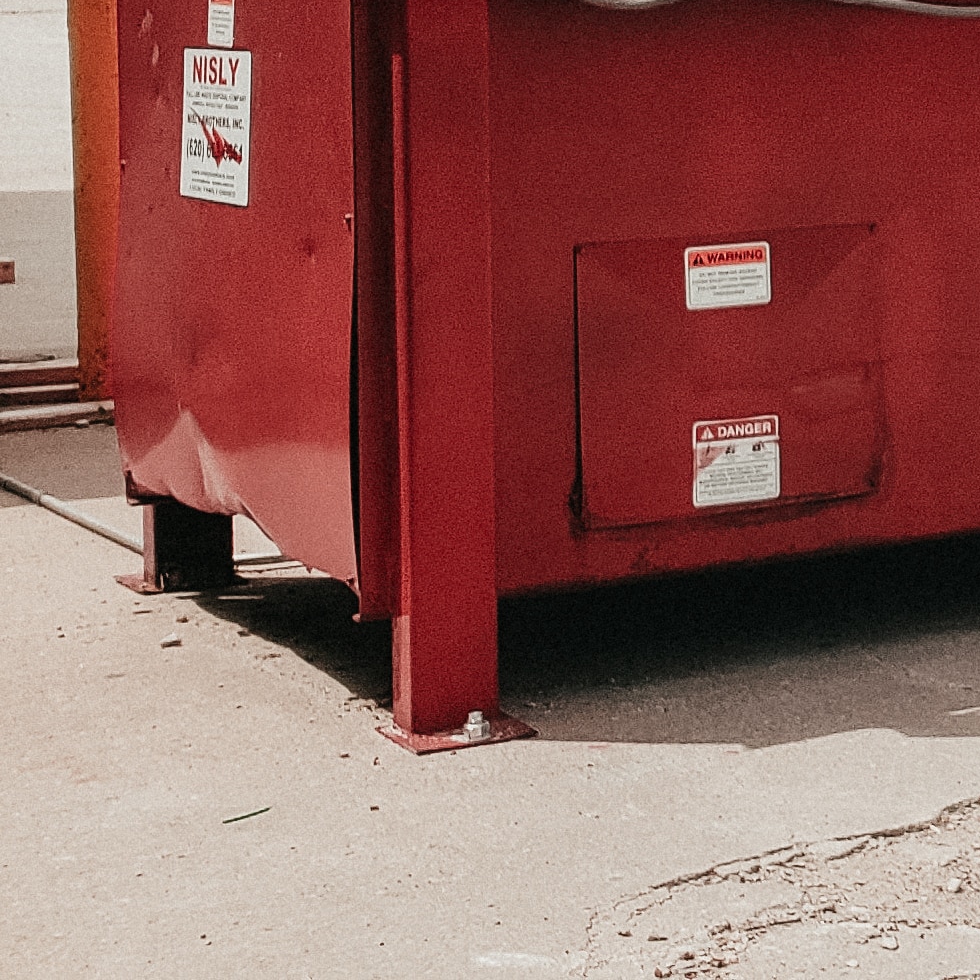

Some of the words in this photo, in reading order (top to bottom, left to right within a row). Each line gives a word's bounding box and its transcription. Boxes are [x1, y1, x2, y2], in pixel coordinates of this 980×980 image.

[192, 54, 240, 87] NISLY
[186, 137, 205, 162] (620)
[707, 249, 763, 264] WARNING
[717, 422, 772, 439] DANGER
